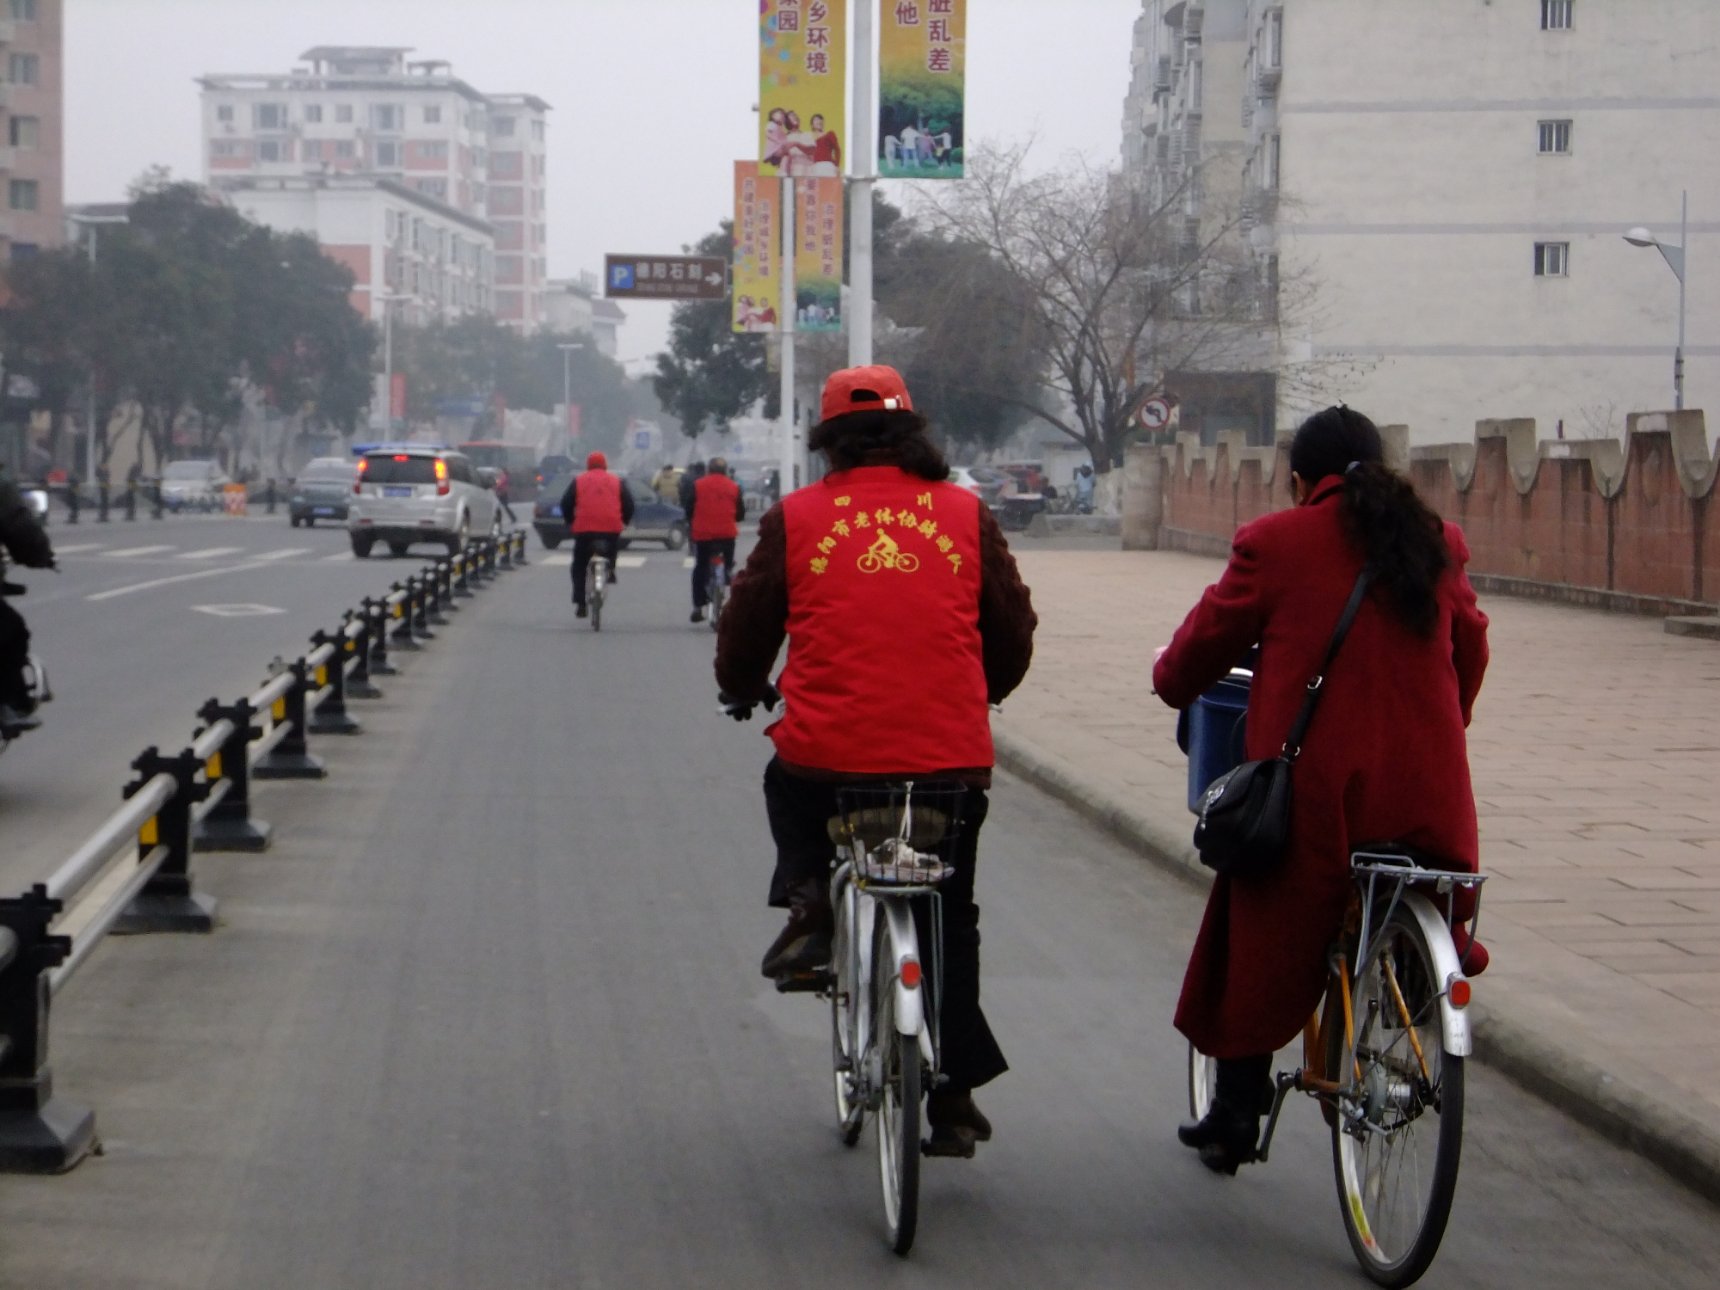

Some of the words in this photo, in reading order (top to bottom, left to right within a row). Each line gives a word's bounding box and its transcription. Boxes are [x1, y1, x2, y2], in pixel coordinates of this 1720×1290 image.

[896, 2, 919, 25] 他
[807, 2, 828, 73] 乡环境
[614, 266, 629, 285] P
